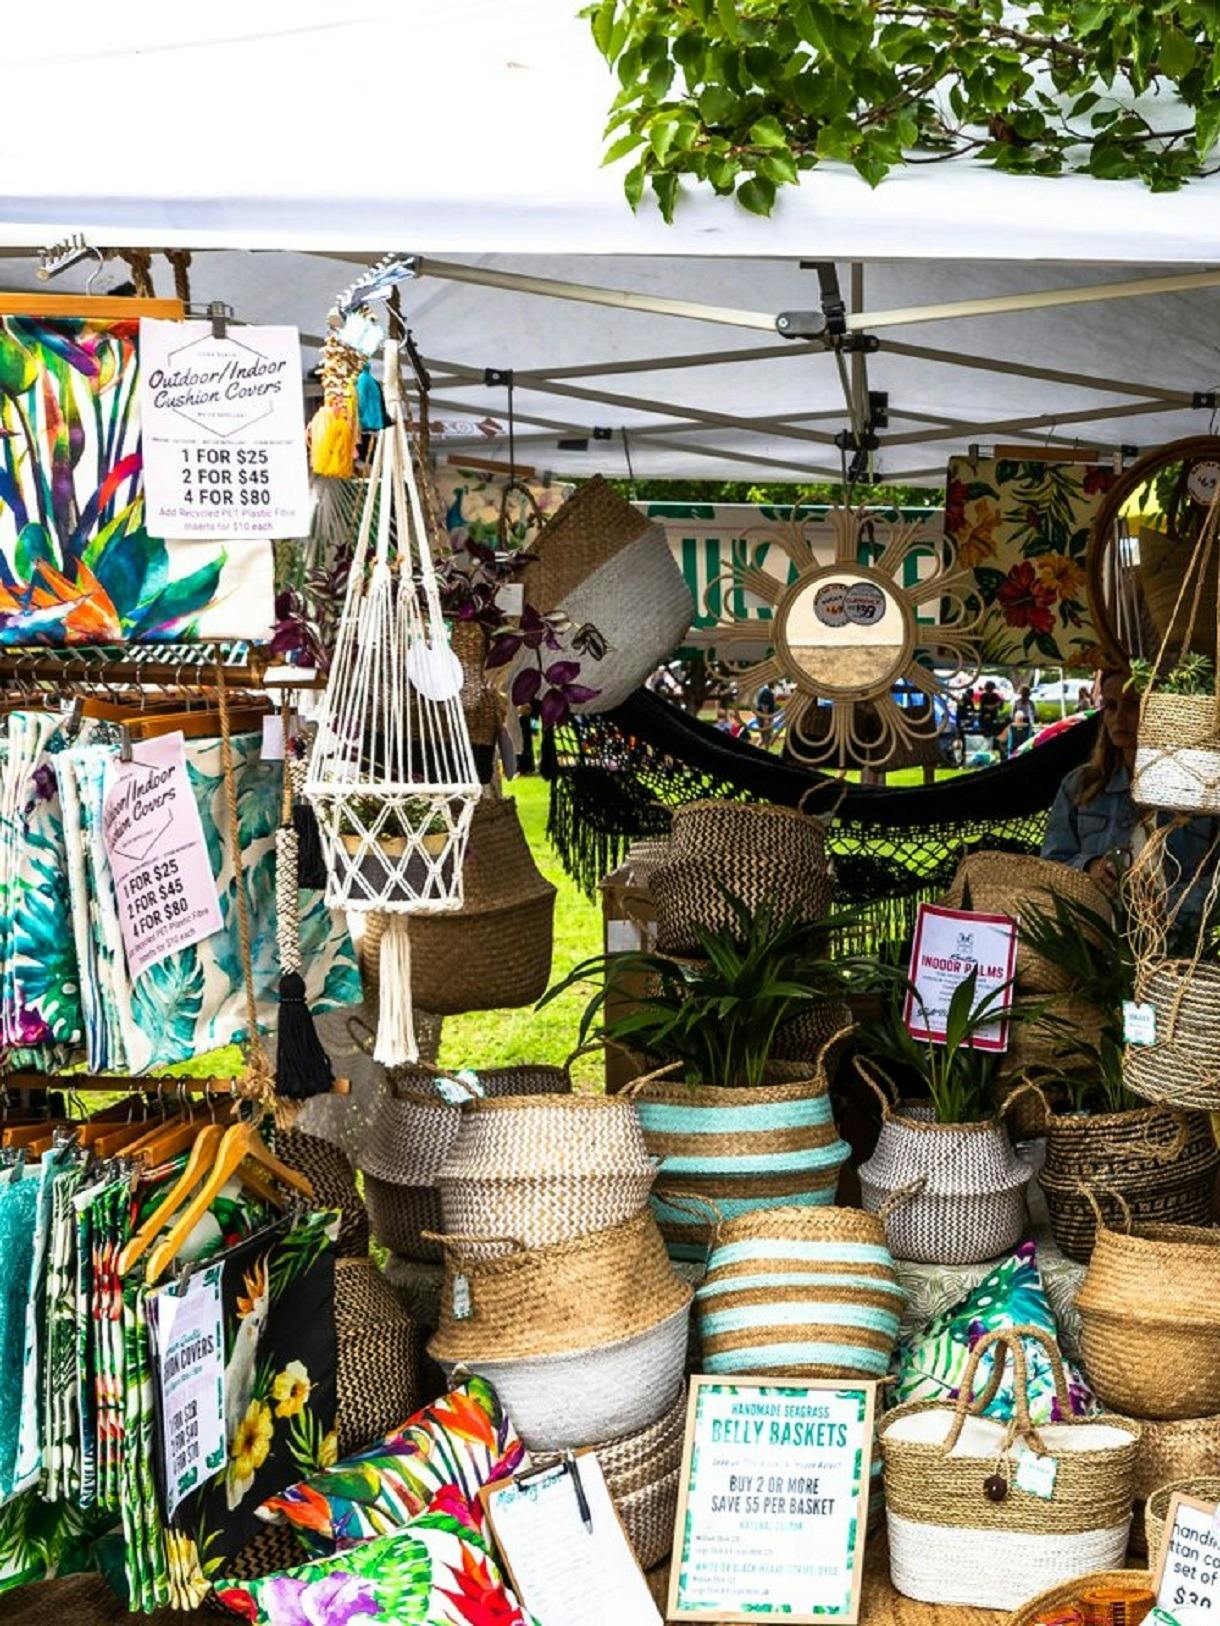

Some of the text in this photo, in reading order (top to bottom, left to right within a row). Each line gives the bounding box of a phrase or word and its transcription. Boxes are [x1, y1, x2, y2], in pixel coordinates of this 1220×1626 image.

[148, 357, 287, 389] Outdoor/Indoor
[154, 380, 281, 408] Cushion Covers
[182, 448, 269, 465] 1 FOR $25
[182, 468, 270, 485] 2 FOR $45
[184, 488, 271, 506] 4 FOR $80
[133, 788, 176, 821] Covers
[123, 885, 130, 899] 1
[129, 871, 153, 895] FOR
[153, 858, 179, 882] $25
[127, 878, 184, 919] 2 FOR $45
[140, 910, 163, 934] FOR
[163, 897, 189, 921] $80
[922, 955, 961, 973] INDOOR
[964, 963, 1004, 978] PLMS
[180, 1334, 215, 1369] COVERS
[732, 1403, 830, 1419] HANDMADE SEAGRASS
[712, 1419, 848, 1448] BELLY BASKETS
[729, 1475, 819, 1495] BUY 2 OR MORE
[711, 1495, 835, 1515] SAVE $5 PER BASKET
[1174, 1562, 1196, 1580] set
[1201, 1571, 1219, 1586] of
